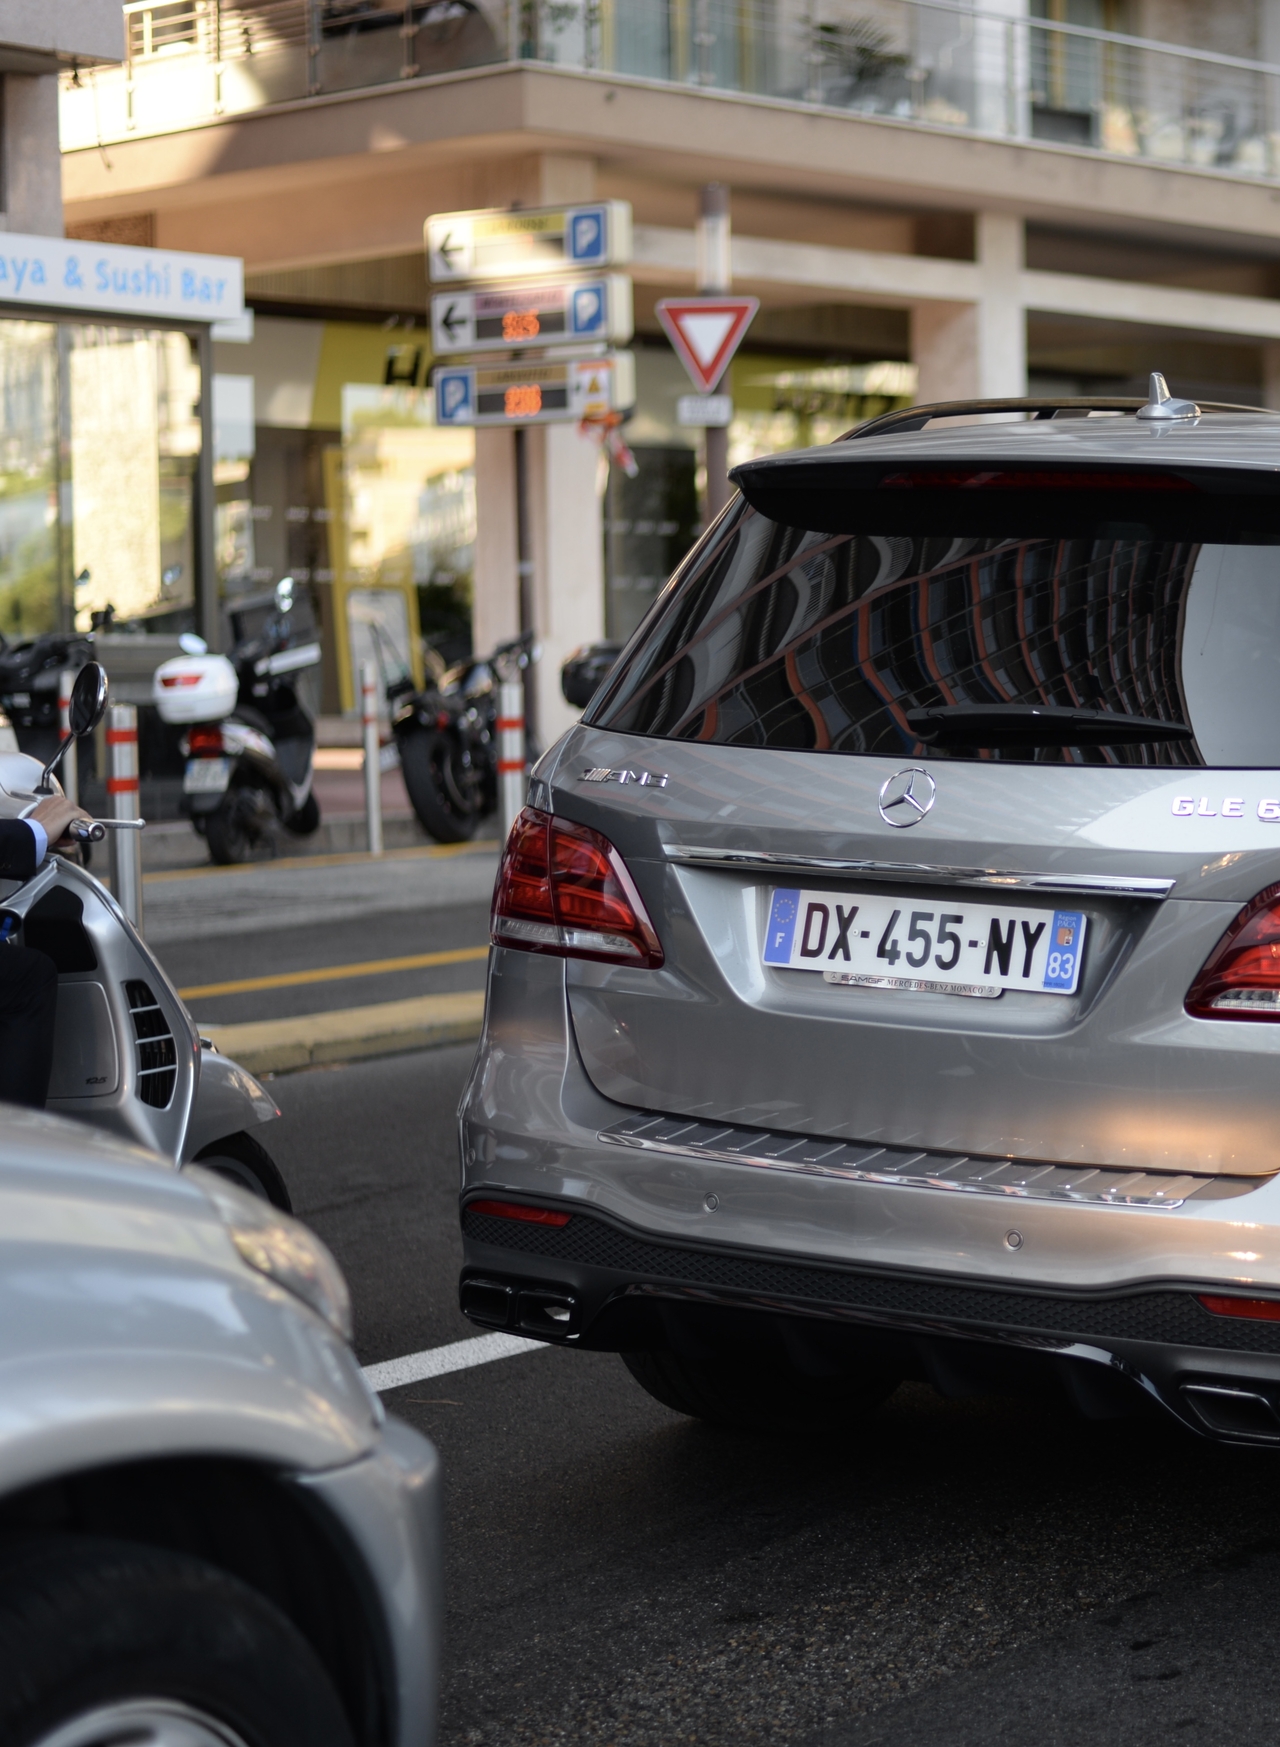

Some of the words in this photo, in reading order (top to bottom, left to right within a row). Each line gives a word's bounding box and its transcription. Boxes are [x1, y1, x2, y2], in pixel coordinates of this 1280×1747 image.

[64, 255, 82, 290] &
[95, 257, 170, 298] Sushi
[181, 268, 227, 303] Bar
[1171, 796, 1245, 817] GLE
[1057, 920, 1077, 928] PACA
[775, 932, 785, 948] F
[800, 902, 1046, 978] DX-455-NY
[1047, 952, 1074, 979] 83
[886, 979, 949, 992] MERCEDES-BENZ
[950, 985, 984, 994] MONACO
